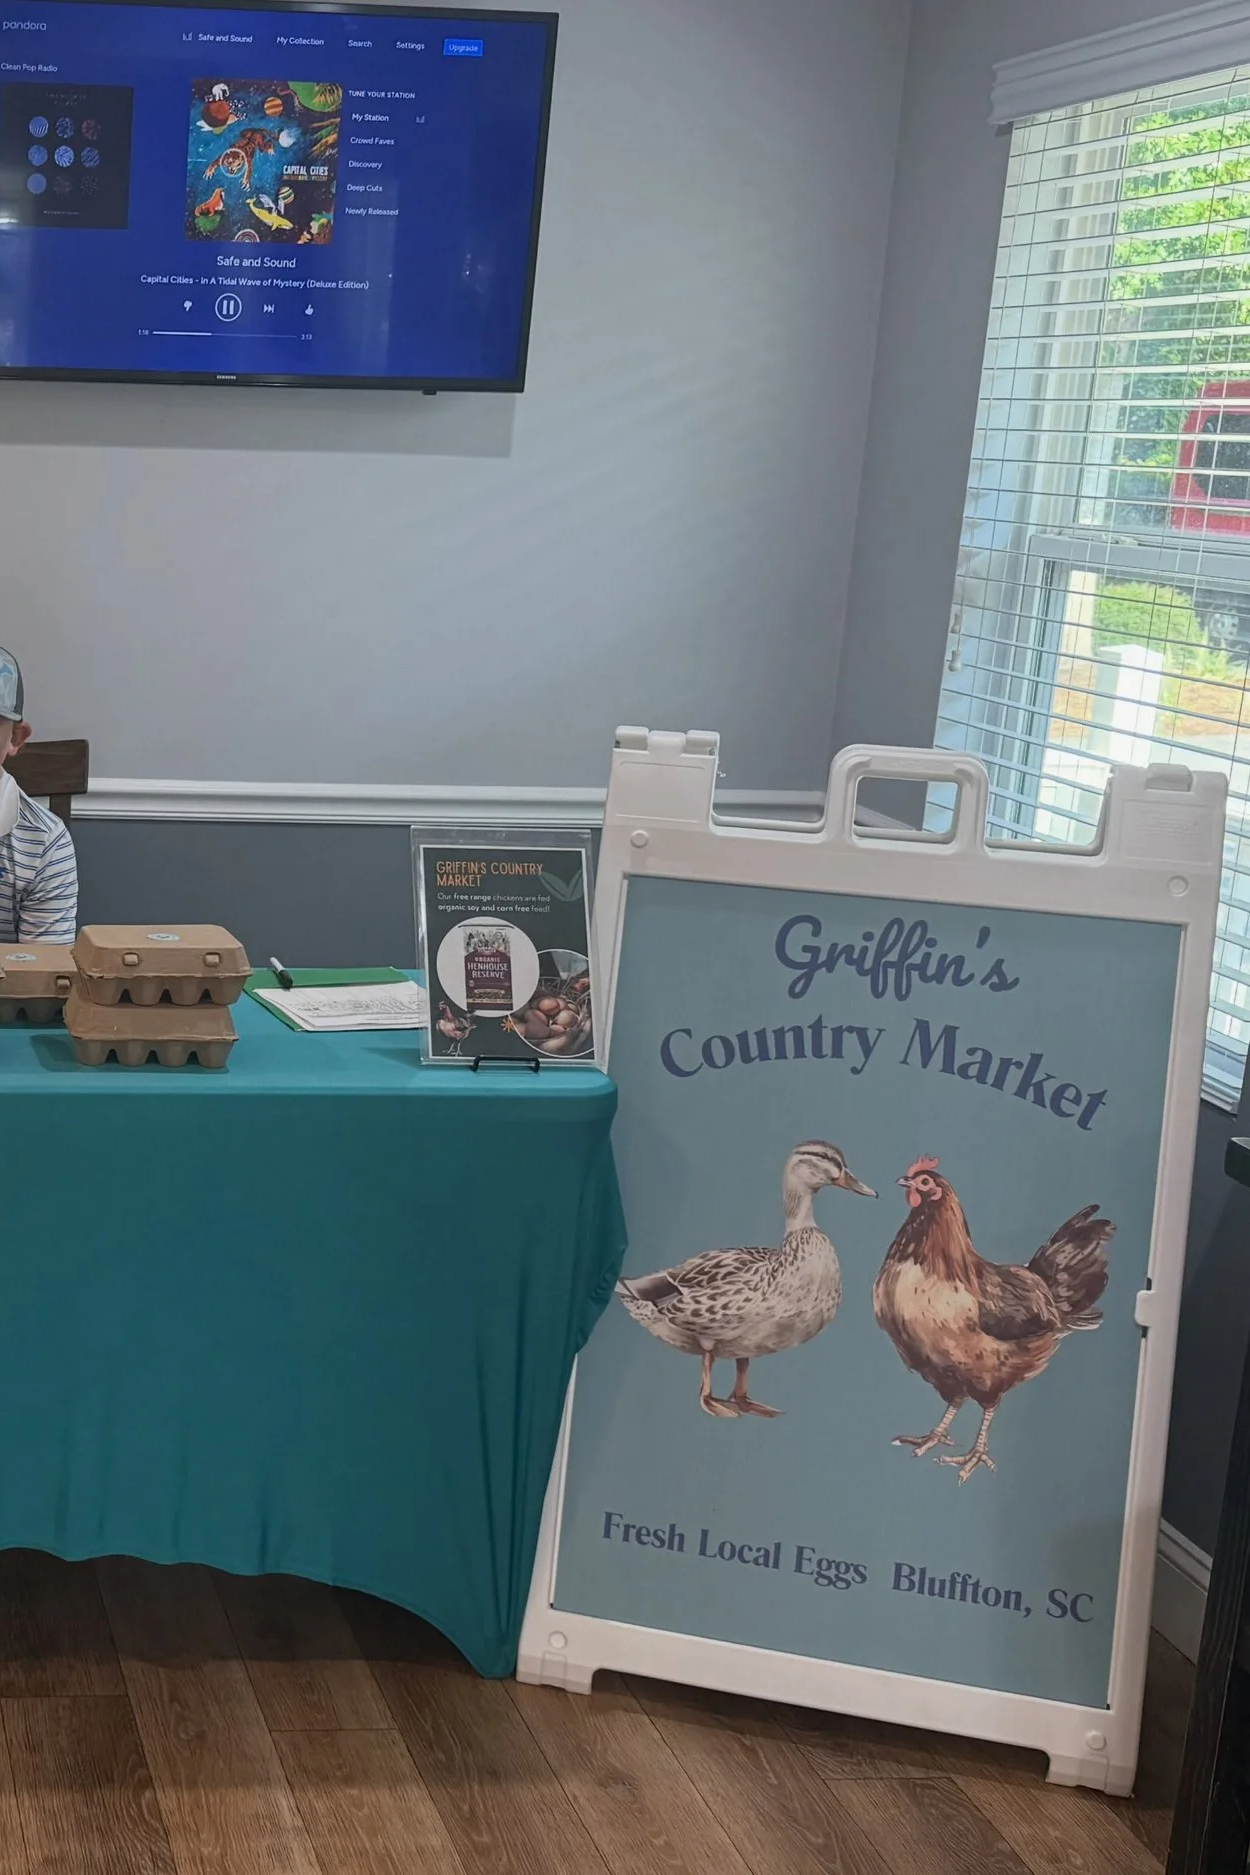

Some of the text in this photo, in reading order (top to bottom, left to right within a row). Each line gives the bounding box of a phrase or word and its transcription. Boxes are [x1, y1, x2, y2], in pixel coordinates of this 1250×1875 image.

[2, 20, 47, 31] pandora
[198, 33, 253, 43] Safe and Sound
[276, 36, 325, 46] My Collection
[348, 40, 373, 48] Search
[396, 42, 425, 51] Settings
[448, 44, 479, 53] Upgrade
[0, 62, 58, 73] Clean Pop Radio
[348, 90, 416, 99] TUNE YOUR STATION
[352, 113, 390, 124] My Station
[350, 136, 395, 146] Crowd Faves
[283, 164, 329, 176] CAPITAL CITIES
[348, 160, 383, 170] Discovery
[346, 184, 383, 194] Deep Cuts
[345, 207, 399, 217] Newly Released
[216, 256, 296, 268] Safe and Sound
[140, 274, 170, 285] Capital
[170, 275, 194, 285] Cities
[200, 276, 209, 285] In
[210, 277, 217, 286] A
[218, 276, 237, 286] Tidal
[238, 278, 262, 286] Wave
[262, 278, 272, 287] of
[272, 278, 306, 290] Mystery
[306, 279, 337, 290] (Deluxe
[338, 280, 370, 290] Edition)
[436, 861, 544, 876] GRIFFIN'S COUNTRY
[436, 874, 482, 888] MARKET
[437, 892, 452, 900] Our
[453, 892, 469, 900] free
[470, 894, 492, 903] range
[492, 894, 523, 902] chickens
[537, 894, 551, 902] fed
[438, 904, 466, 913] organic
[514, 904, 530, 912] free
[530, 905, 551, 913] feed!
[774, 914, 1020, 1002] Griffin's
[468, 962, 509, 972] HENHOUSE
[472, 970, 506, 979] RESERVE
[659, 1013, 1110, 1132] Country Market
[601, 1511, 1095, 1624] Fresh Local Eggs Bluffton, SC
